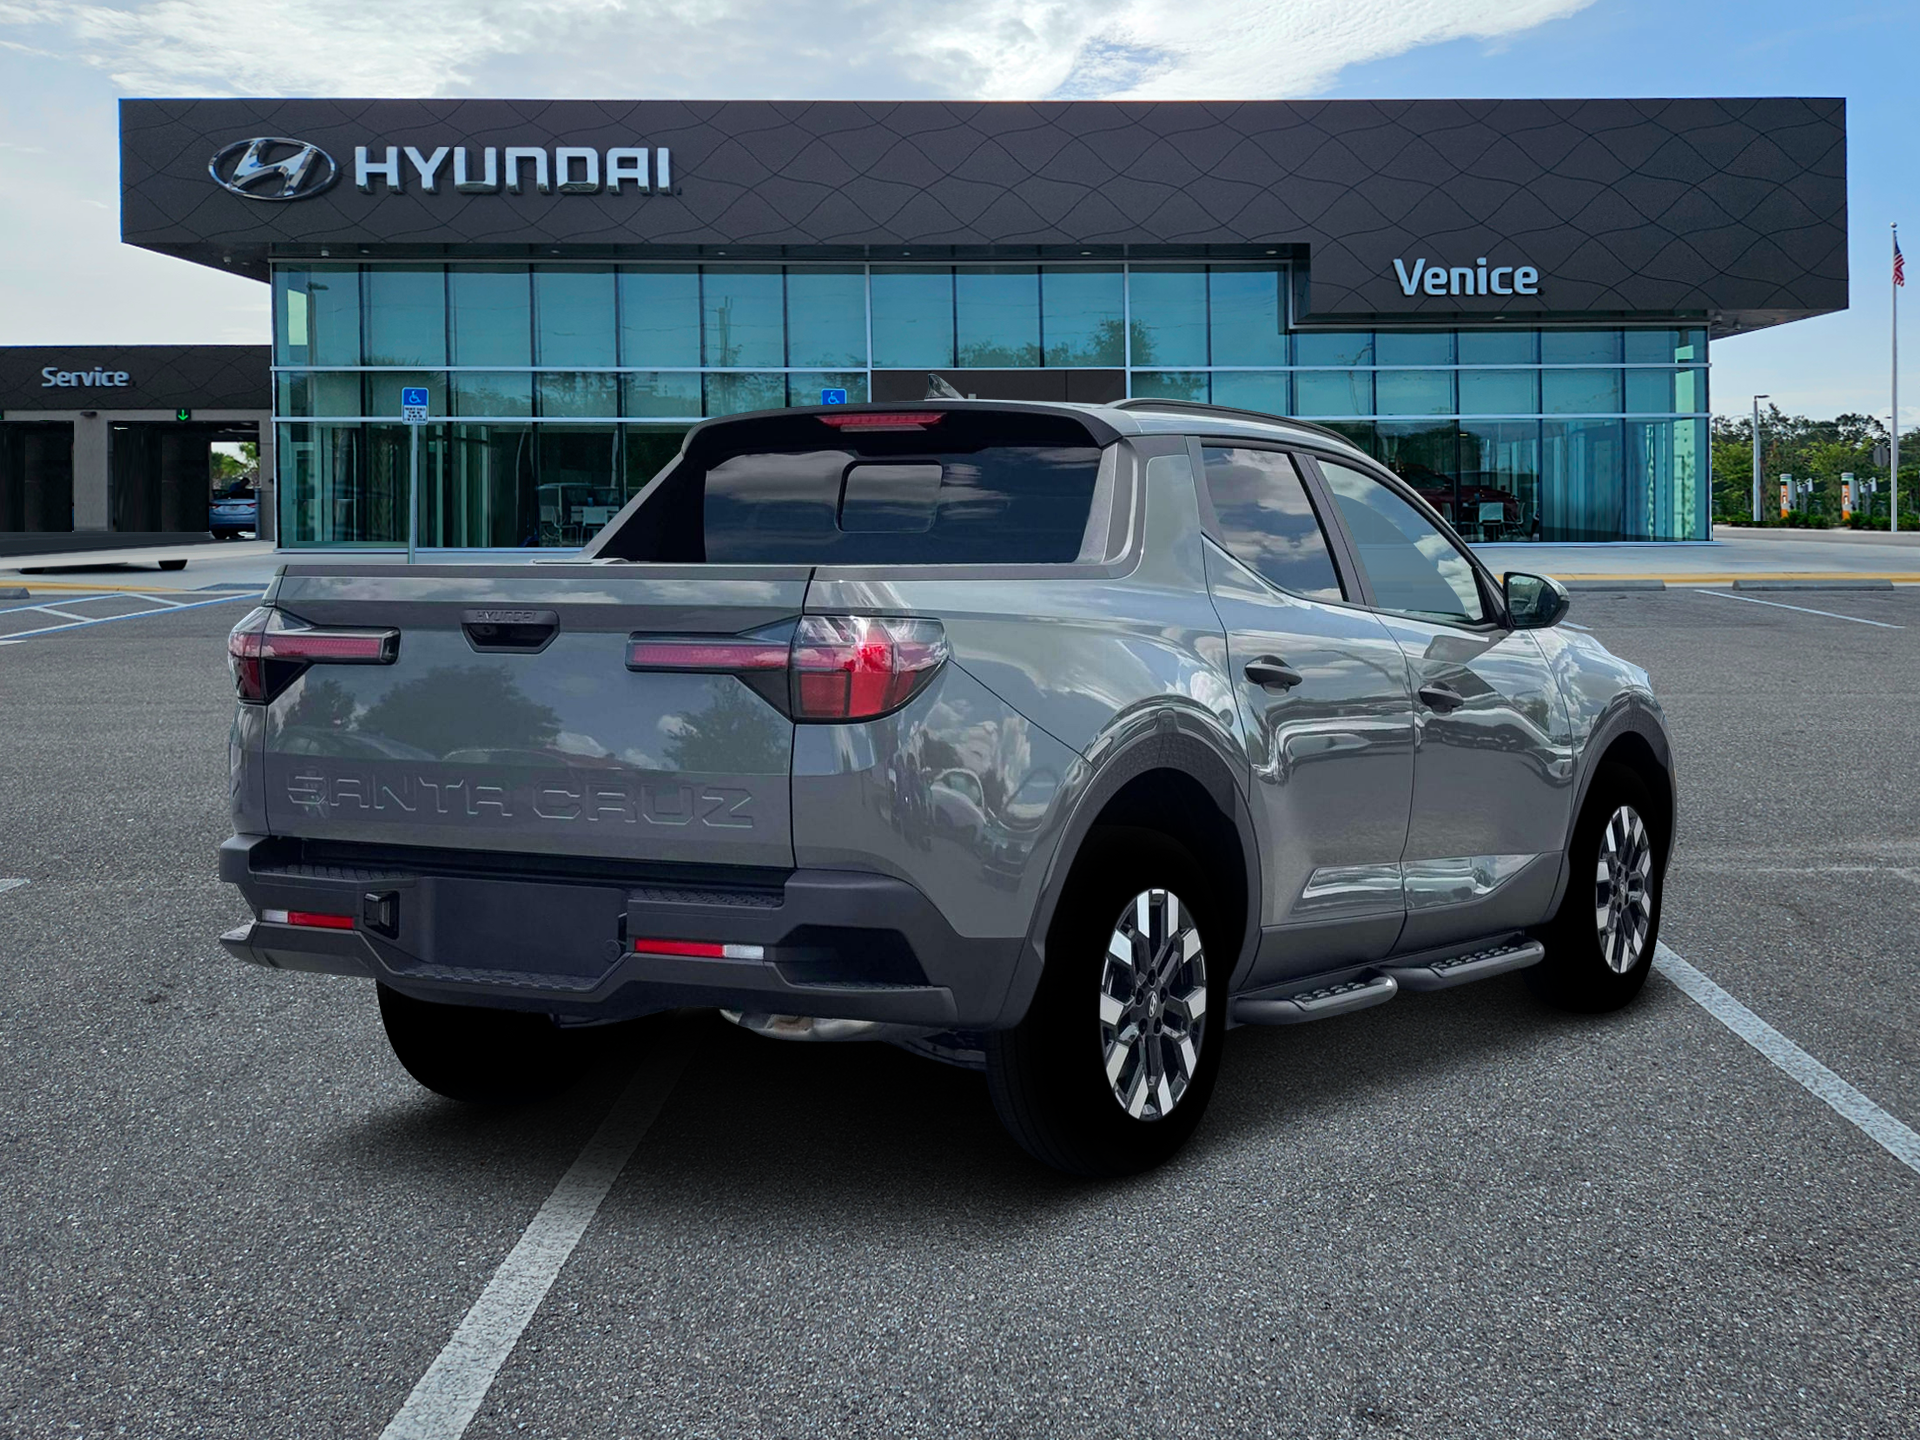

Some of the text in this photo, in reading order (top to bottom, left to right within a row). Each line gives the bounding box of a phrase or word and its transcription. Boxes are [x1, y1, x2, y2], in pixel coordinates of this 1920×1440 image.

[354, 145, 675, 195] HYUNDAI
[1392, 256, 1540, 297] Venice
[41, 366, 131, 388] Service
[474, 610, 538, 624] HYUNDAI
[286, 773, 754, 829] SANTA CRUZ
